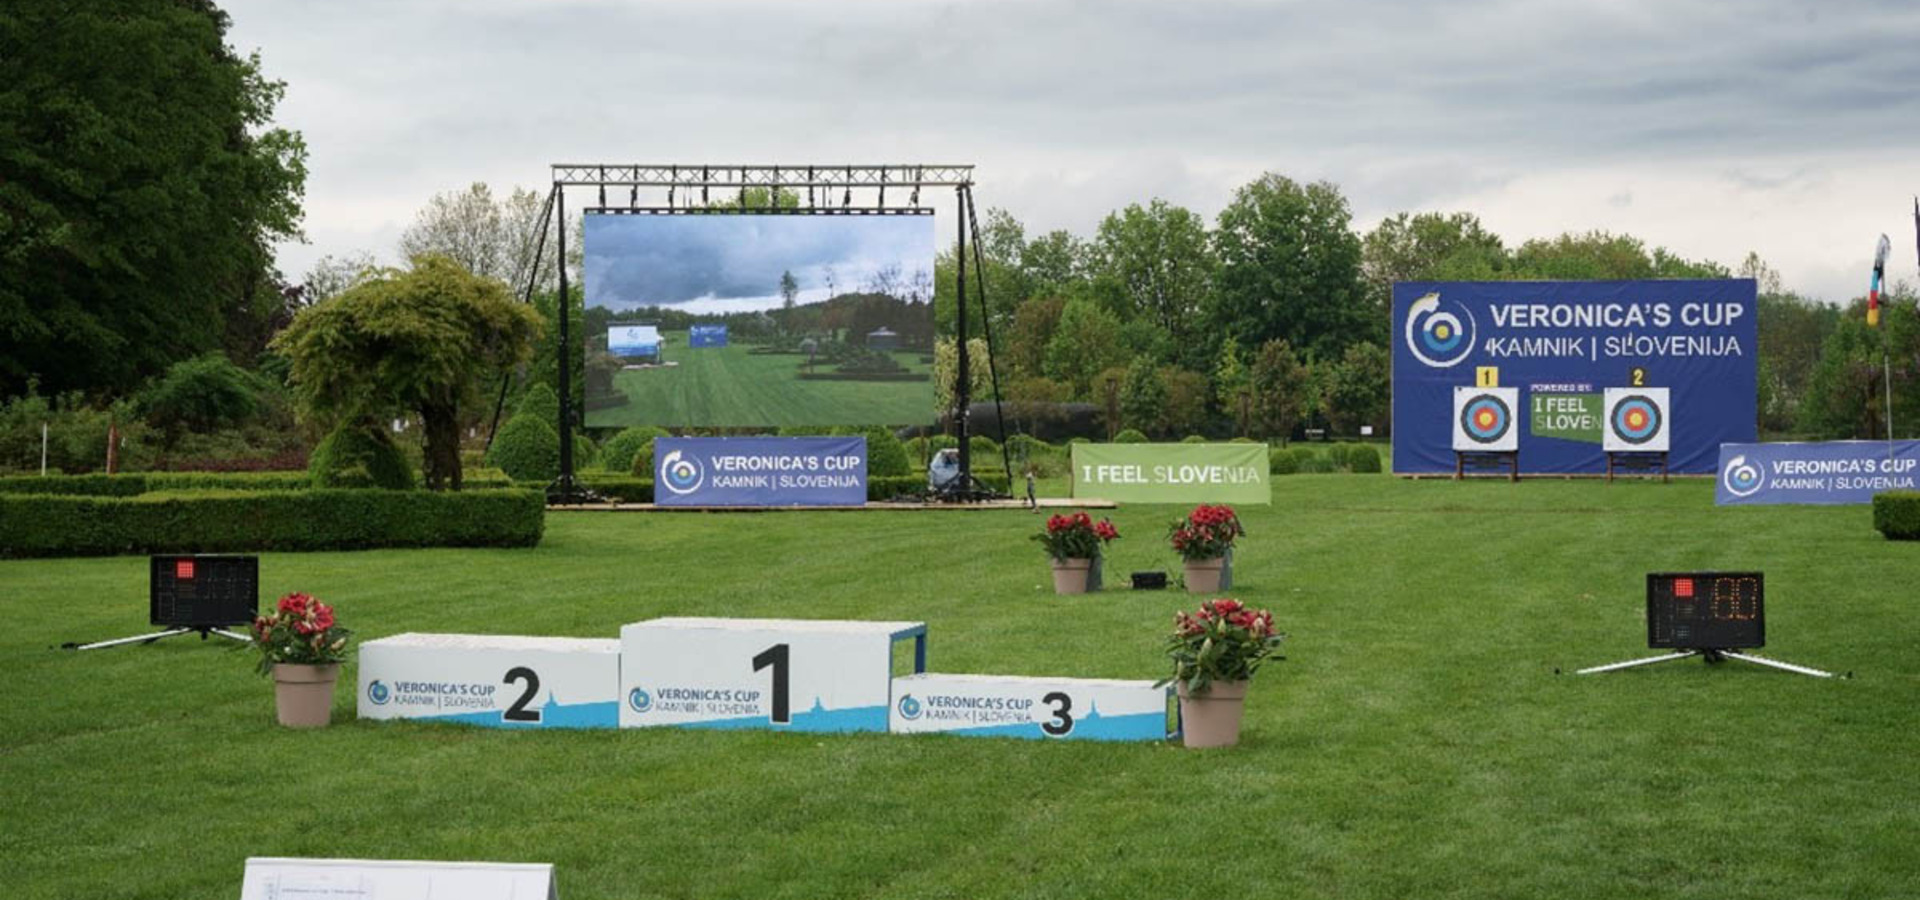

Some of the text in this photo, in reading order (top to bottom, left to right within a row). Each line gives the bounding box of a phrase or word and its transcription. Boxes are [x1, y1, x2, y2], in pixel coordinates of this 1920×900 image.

[1489, 302, 1744, 328] VERONICA'S CUP
[1491, 337, 1584, 358] KAMNIK
[1604, 335, 1742, 357] SLOVENIJA
[1483, 370, 1490, 385] 1
[1633, 369, 1643, 385] 2
[1531, 384, 1575, 392] POWERED
[1535, 398, 1587, 412] I FEEL
[1536, 415, 1602, 430] SLOVEN
[712, 456, 860, 471] VERONICA'S CUP
[1772, 459, 1916, 474] VERONICA'S CUP
[712, 476, 768, 488] KAMNIK
[780, 475, 860, 488] SLOVENIJA
[1083, 465, 1260, 484] I FEEL SLOVENIA
[1771, 478, 1824, 490] KAMNIK
[1836, 477, 1915, 489] SLOVENIJA
[394, 682, 495, 696] VERONICA'S CUP
[752, 643, 790, 723] 1
[503, 666, 540, 721] 2
[657, 688, 759, 702] VERONICA'S CUP
[927, 696, 1033, 710] VERONICA'S CUP
[1041, 691, 1073, 736] 3
